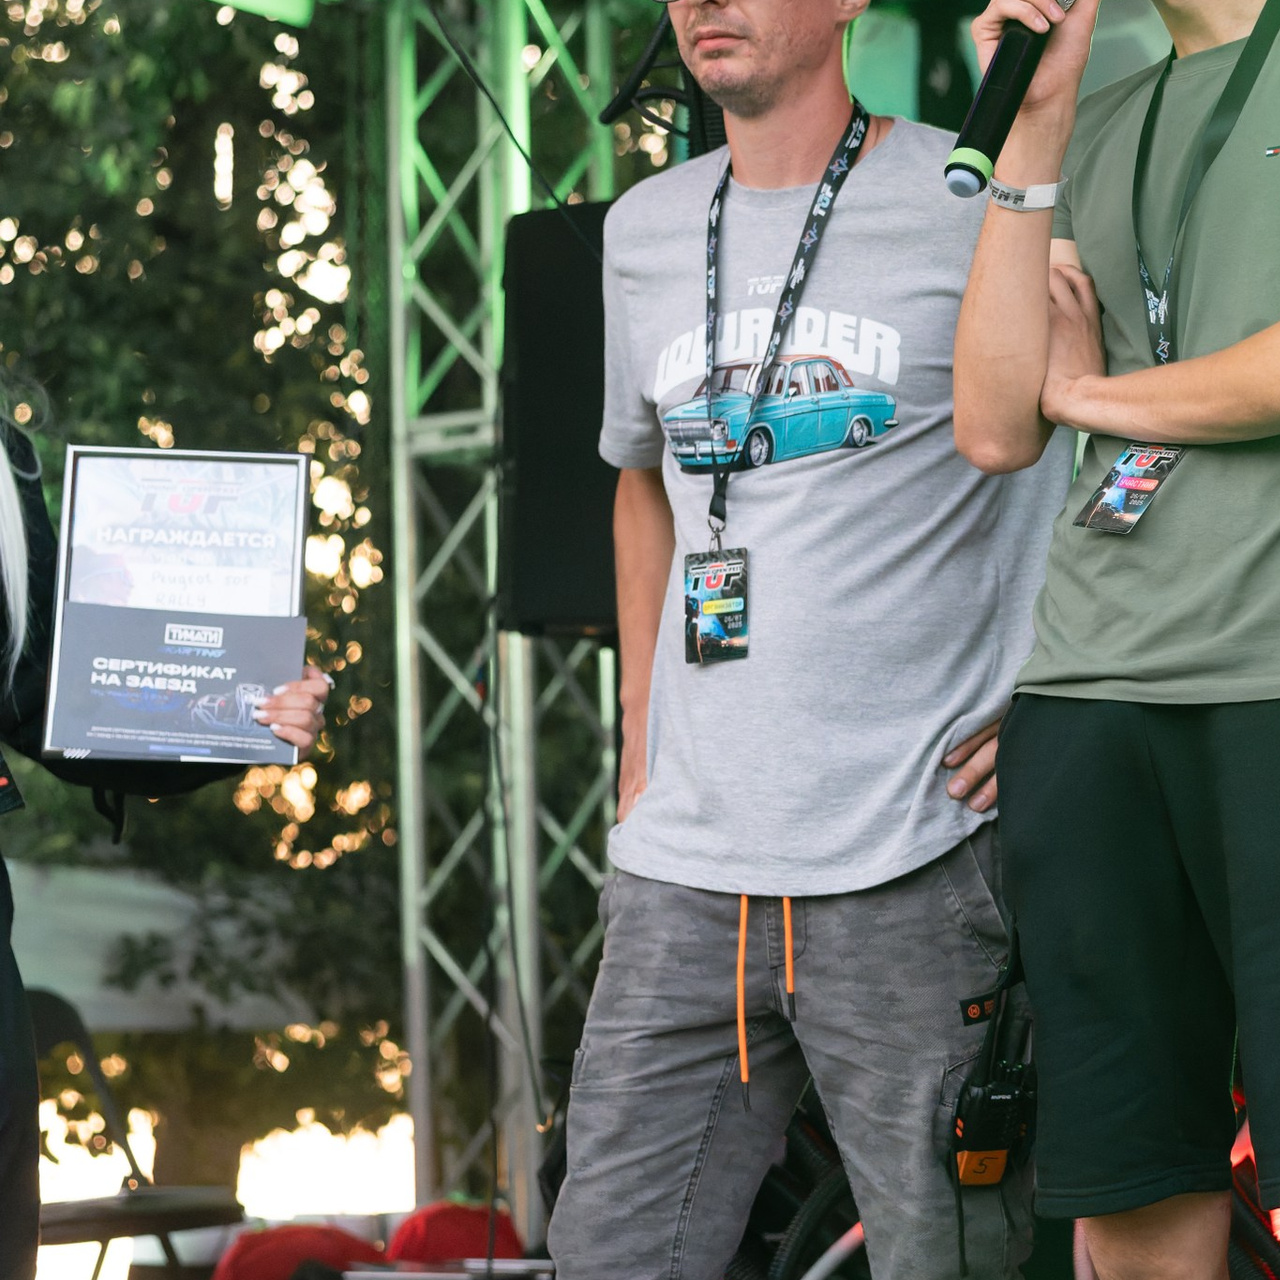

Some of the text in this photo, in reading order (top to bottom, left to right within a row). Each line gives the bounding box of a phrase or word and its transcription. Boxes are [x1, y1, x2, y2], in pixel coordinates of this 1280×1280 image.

[747, 274, 785, 296] TOF
[96, 526, 277, 548] НАГРАЖДАЕТСЯ
[92, 657, 237, 680] СЕРТИФИКАТ
[90, 671, 197, 694] НА ЗАЕЗД
